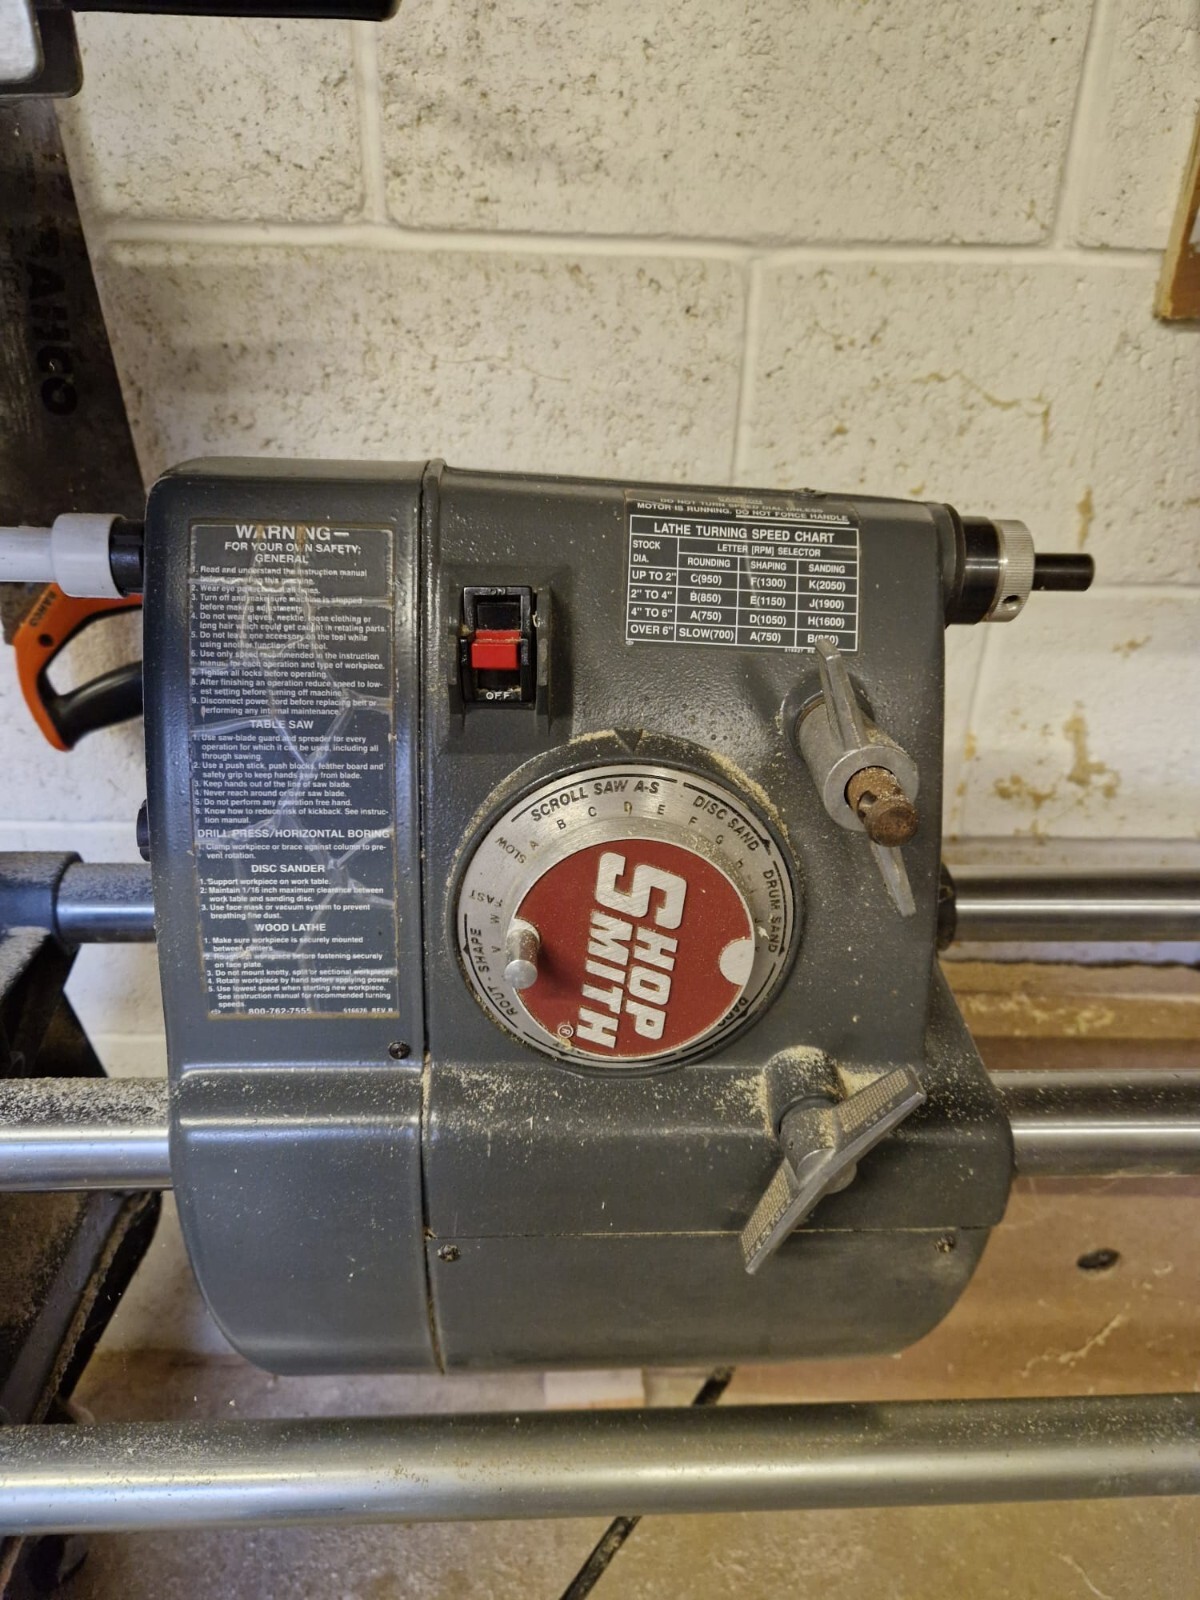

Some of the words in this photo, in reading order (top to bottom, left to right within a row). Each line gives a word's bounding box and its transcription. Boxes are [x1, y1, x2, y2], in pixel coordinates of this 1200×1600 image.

[637, 503, 671, 511] MOTOR
[775, 511, 807, 519] FORCE
[810, 513, 848, 521] HANDLE
[654, 522, 691, 535] LATHE
[695, 525, 747, 539] TURNING
[752, 528, 790, 541] SPEED
[794, 532, 834, 544] CHART
[225, 542, 248, 550] FOR
[252, 542, 282, 551] YOUR
[632, 540, 660, 550] STOCK
[717, 544, 748, 553] LETTER
[778, 547, 821, 557] SELECTOR
[255, 554, 308, 563] GENERAL
[633, 554, 649, 563] DIA.
[688, 557, 730, 567] ROUNDING
[750, 561, 787, 571] SHAPING
[808, 564, 845, 574] SANDING
[632, 571, 646, 580] UP
[649, 571, 662, 580] TO
[665, 572, 677, 582] 2"
[690, 574, 722, 585] C(950)
[750, 577, 786, 589] F(1300)
[809, 580, 846, 592] K(2050)
[631, 589, 642, 598] 2"
[645, 590, 658, 599] TO
[661, 591, 672, 600] 4"
[690, 592, 721, 604] B(850)
[750, 596, 786, 607] E(1150)
[809, 598, 845, 610] J(1900)
[631, 607, 642, 617] 4"
[645, 608, 659, 618] TO
[661, 609, 672, 618] 6"
[690, 610, 722, 622] A(750)
[750, 614, 787, 626] D(1050)
[808, 616, 845, 628] H(1600)
[200, 623, 216, 631] long
[219, 623, 233, 631] hair
[261, 624, 281, 632] could
[284, 624, 295, 632] get
[334, 625, 363, 633] rotating
[365, 625, 386, 633] parts.
[630, 625, 659, 635] OVER
[662, 626, 673, 636] 6"
[679, 628, 734, 640] SLOW(700)
[750, 631, 781, 643] A(750)
[200, 679, 218, 687] After
[221, 679, 253, 687] finishing
[268, 680, 303, 688] operation
[305, 680, 331, 688] reduce
[333, 680, 355, 688] speed
[200, 689, 212, 697] est
[215, 689, 240, 697] setting
[242, 689, 266, 697] before
[486, 692, 511, 700] OFF
[250, 720, 285, 729] TABLE
[289, 720, 314, 729] SAW
[202, 762, 217, 770] Use
[219, 762, 223, 770] a
[226, 762, 244, 770] push
[269, 762, 287, 770] push
[530, 786, 588, 822] SCROLL
[594, 780, 629, 796] SAW
[634, 781, 660, 794] A-S
[588, 806, 597, 817] C
[657, 805, 665, 815] E
[558, 819, 567, 830] B
[692, 795, 733, 820] DISC
[727, 816, 761, 852] SAND
[198, 829, 232, 838] DRILL
[234, 829, 344, 838] PRESS/HORIZONTAL
[348, 829, 390, 838] BORING
[716, 834, 724, 845] G
[496, 836, 527, 865] SLOW
[251, 864, 277, 873] DISC
[280, 864, 325, 873] SANDER
[762, 869, 781, 909] DRUM
[469, 890, 504, 908] FAST
[770, 917, 782, 953] SAND
[470, 927, 490, 973] SHAPE
[488, 985, 518, 1016] ROUT
